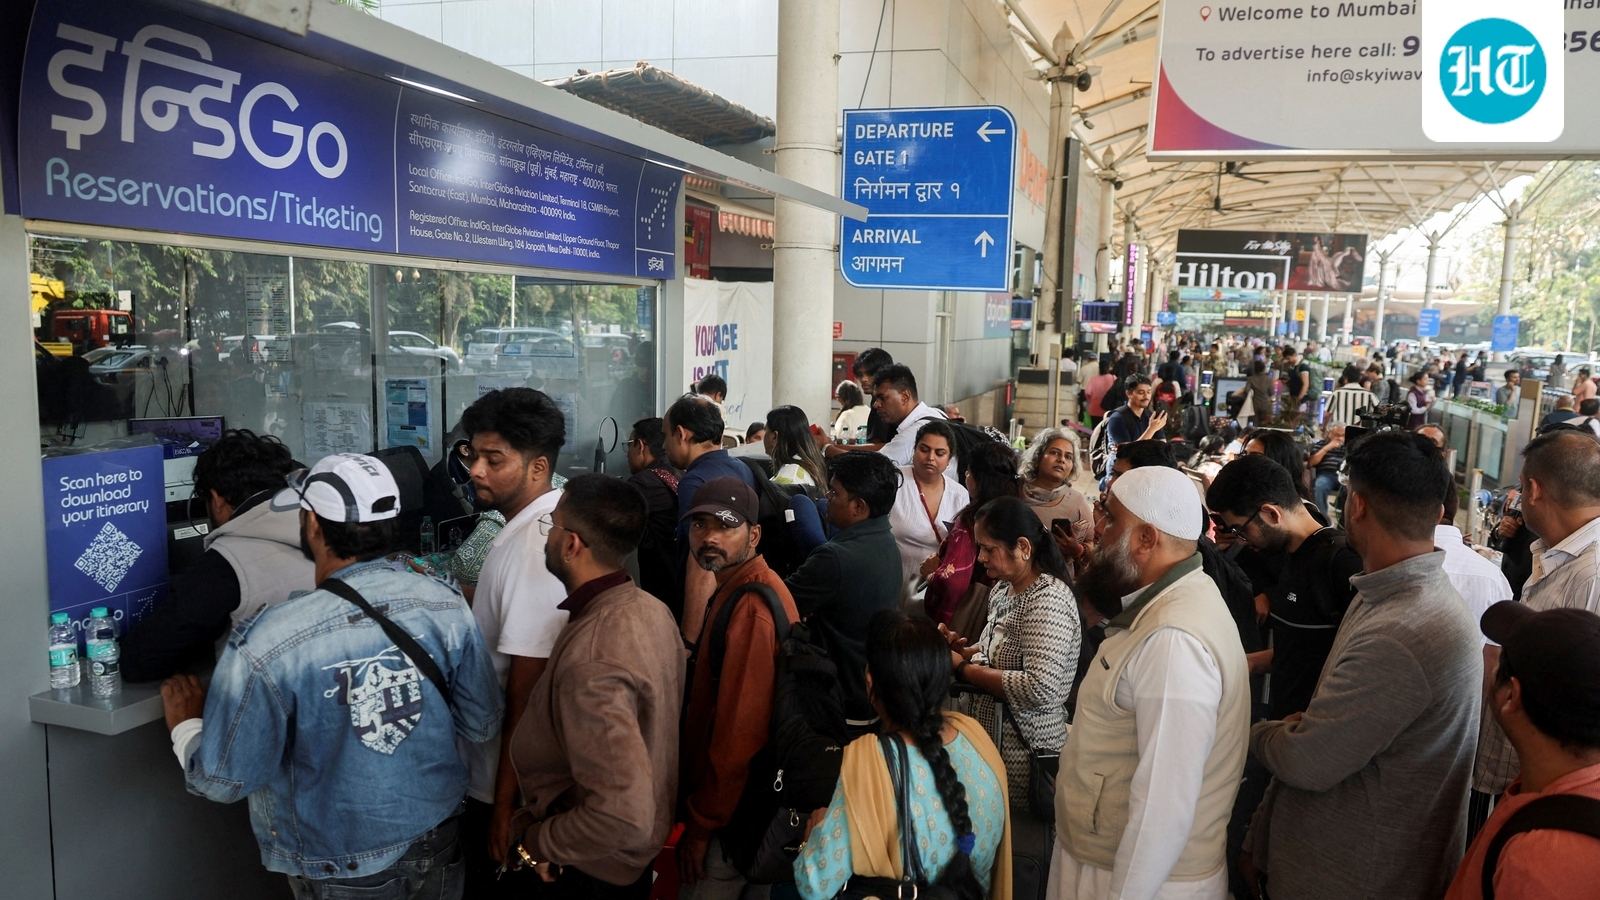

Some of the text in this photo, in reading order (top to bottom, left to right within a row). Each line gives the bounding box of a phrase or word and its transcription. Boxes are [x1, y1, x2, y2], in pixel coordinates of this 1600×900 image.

[1219, 7, 1304, 21] Welcome
[1310, 4, 1330, 18] to
[1337, 1, 1417, 17] Mumbai
[1196, 47, 1215, 61] To
[1221, 45, 1305, 60] advertise
[1311, 45, 1352, 58] here
[1358, 43, 1396, 57] call:
[1564, 30, 1600, 52] 56
[410, 113, 440, 131] स्थानिक
[855, 122, 954, 139] DEPARTURE
[854, 150, 907, 165] GATE 1
[408, 163, 429, 178] Local
[429, 168, 454, 182] Office:
[480, 179, 514, 195] InterGlobe
[514, 185, 539, 200] Aviation
[539, 191, 560, 205] Limited,
[560, 195, 580, 208] Terminal
[408, 180, 446, 198] Santacruz
[447, 188, 470, 204] (East),
[470, 192, 498, 208] Mumbai,
[499, 197, 537, 214] Maharashtra
[854, 176, 911, 199] निर्गमन
[914, 182, 943, 202] द्वार
[46, 157, 383, 243] Reservations/Ticketing
[409, 210, 447, 224] Registered
[448, 215, 469, 228] Office:
[469, 219, 492, 232] IndiGo,
[492, 222, 522, 236] InterGlobe
[522, 227, 544, 239] Aviation
[544, 230, 562, 242] Limited,
[562, 233, 577, 244] Upper
[409, 226, 434, 240] House,
[434, 229, 453, 241] Gate
[453, 231, 465, 242] No.
[465, 233, 472, 244] 2,
[472, 234, 498, 246] Western
[498, 237, 514, 250] Wing,
[852, 229, 921, 244] ARRIVAL
[851, 256, 905, 273] आगमन
[1173, 261, 1276, 290] Hilton
[59, 470, 143, 492] Scan here to
[60, 484, 131, 509] download
[62, 500, 149, 527] your itinerary
